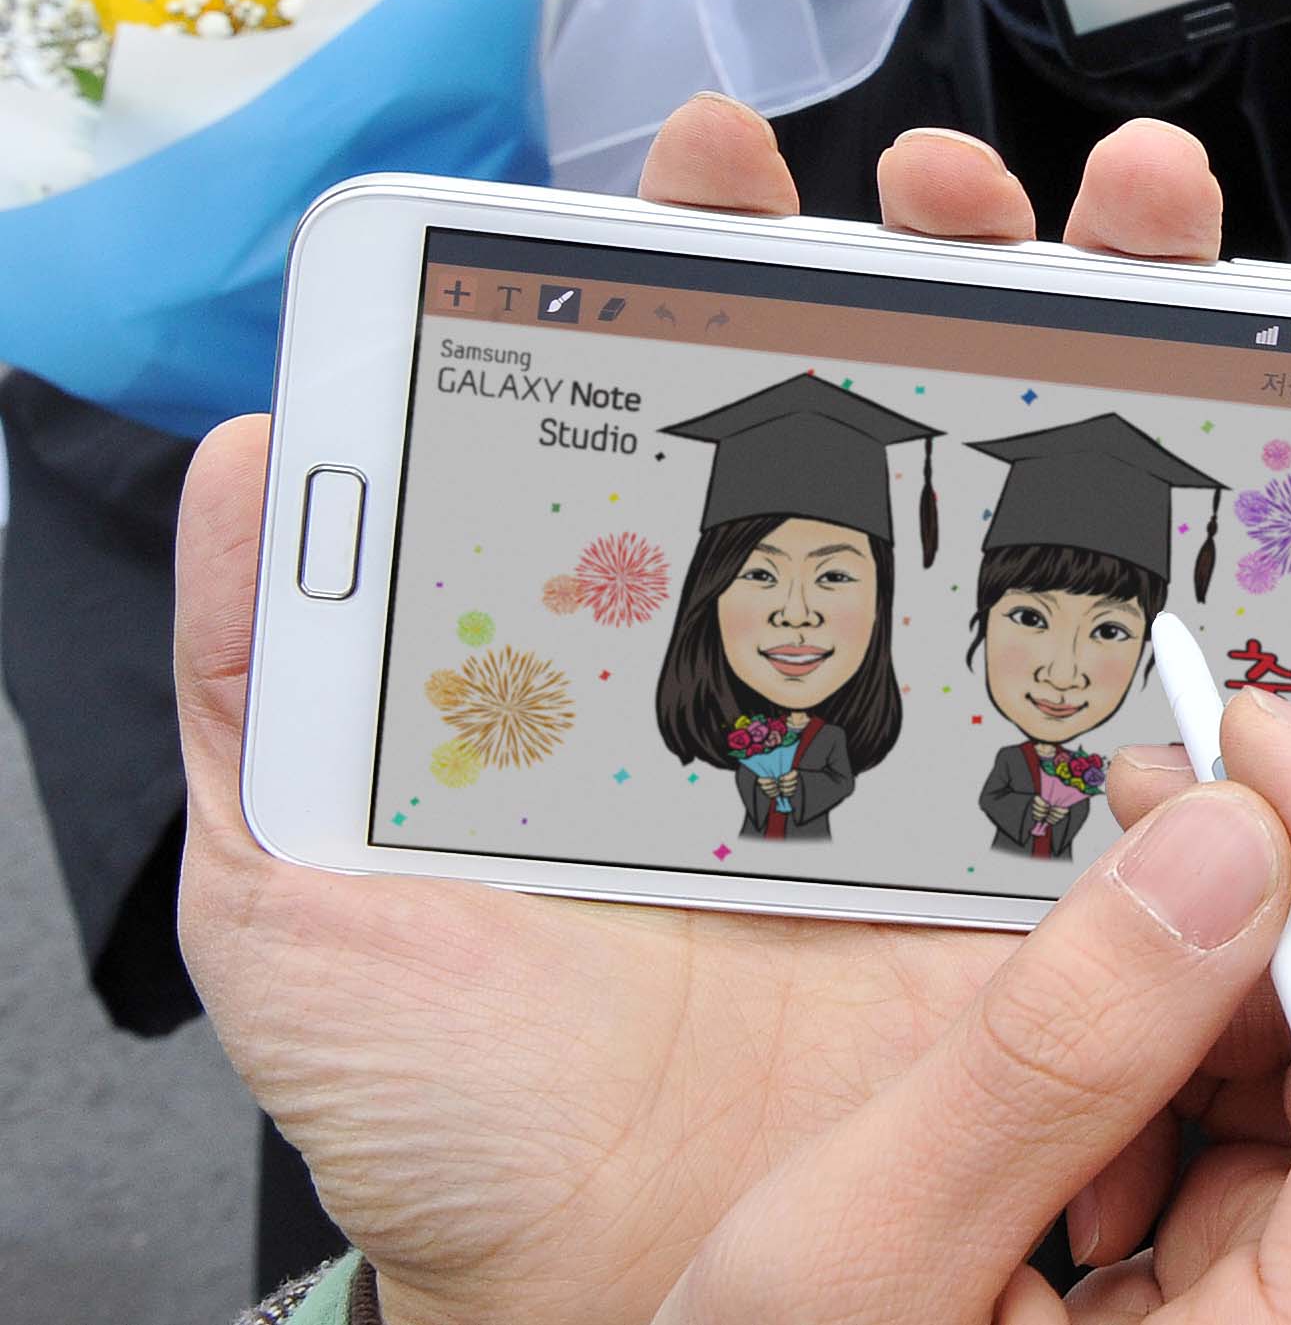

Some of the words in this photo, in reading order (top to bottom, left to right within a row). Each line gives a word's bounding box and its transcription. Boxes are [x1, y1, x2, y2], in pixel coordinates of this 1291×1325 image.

[440, 339, 532, 372] Samsung
[437, 366, 563, 403] GALAXY
[570, 380, 642, 412] Note
[539, 417, 638, 455] Studio
